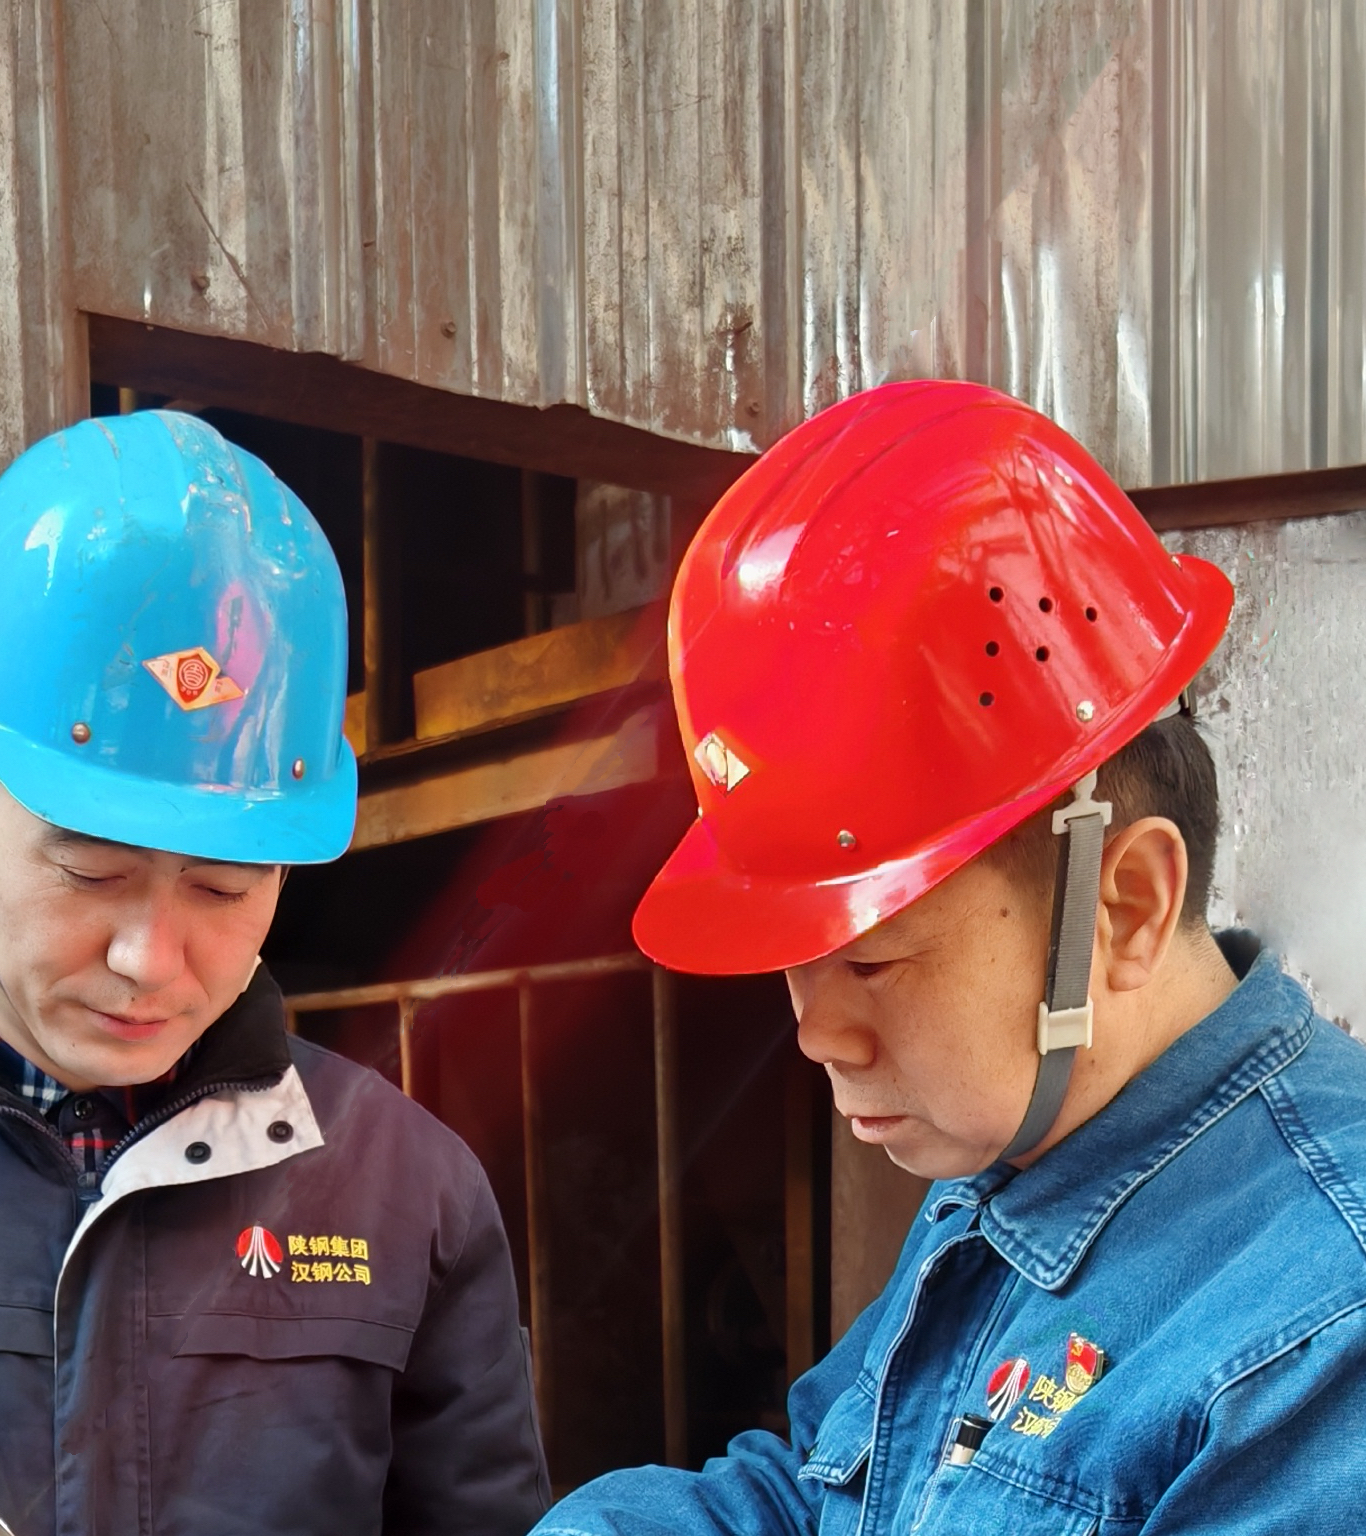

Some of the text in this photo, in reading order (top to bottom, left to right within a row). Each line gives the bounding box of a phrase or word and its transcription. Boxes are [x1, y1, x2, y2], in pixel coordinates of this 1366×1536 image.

[287, 1235, 369, 1261] 陕钢集团
[291, 1261, 372, 1285] 汉钢公司
[1028, 1374, 1084, 1413] 陕钢
